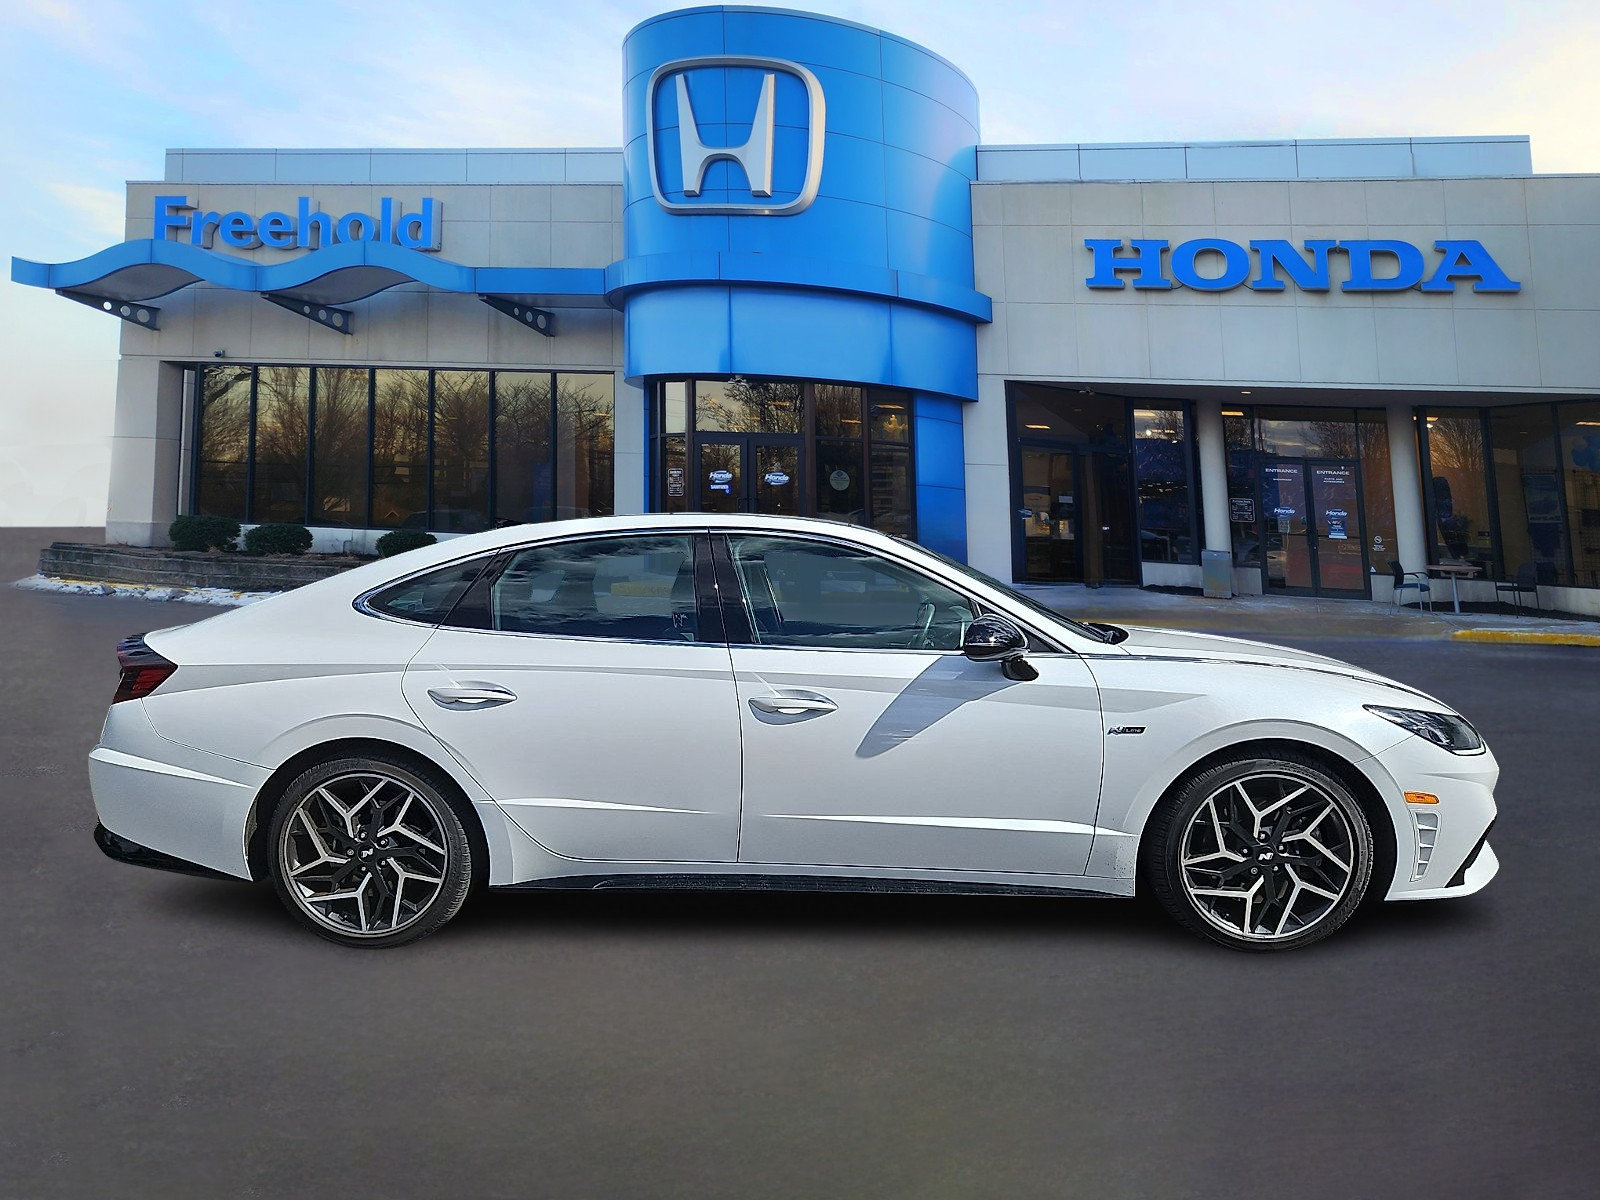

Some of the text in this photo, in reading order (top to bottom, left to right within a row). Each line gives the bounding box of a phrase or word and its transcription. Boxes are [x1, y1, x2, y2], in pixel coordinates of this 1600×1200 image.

[154, 195, 442, 251] Freehold
[1084, 238, 1521, 293] HONDA
[709, 472, 733, 480] Honda
[765, 473, 790, 481] Honda
[1273, 507, 1296, 515] Honda
[1325, 510, 1348, 518] Honda
